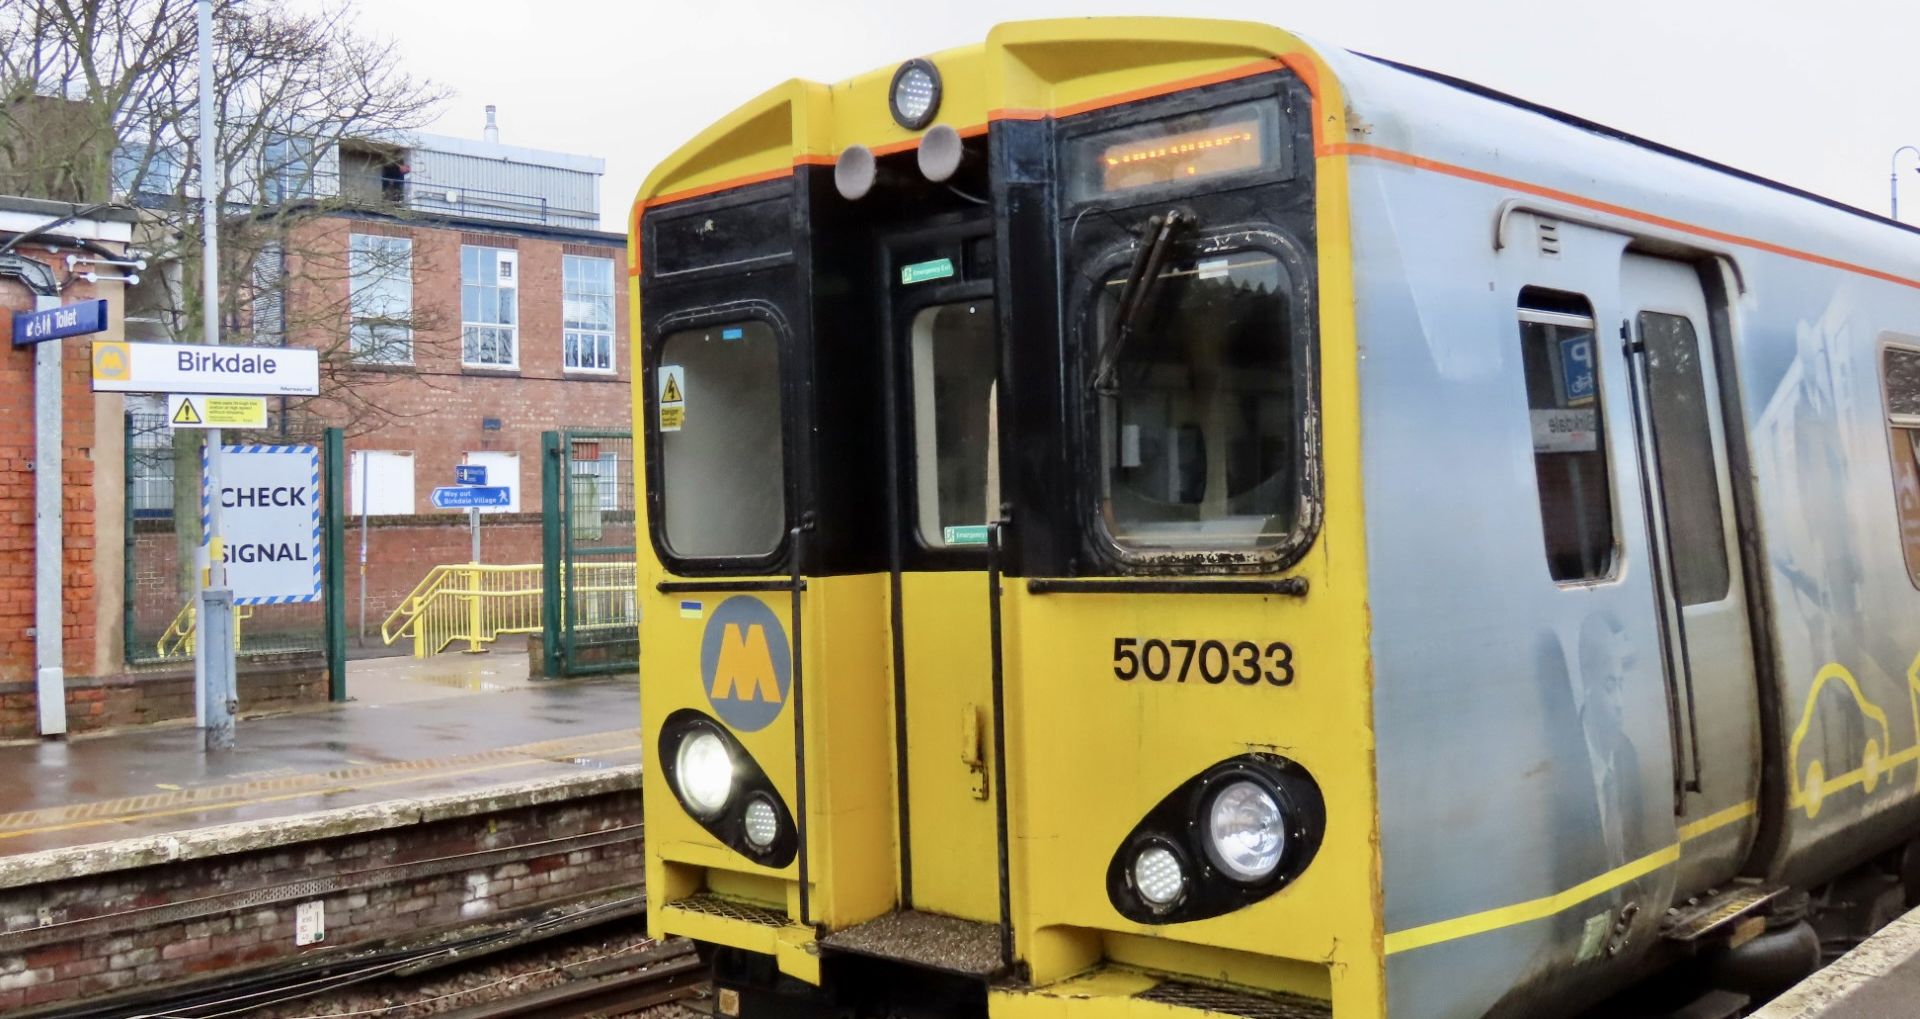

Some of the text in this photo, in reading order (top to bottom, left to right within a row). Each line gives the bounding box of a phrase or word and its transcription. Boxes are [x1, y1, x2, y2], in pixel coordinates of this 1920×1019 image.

[55, 307, 77, 329] Toilet
[178, 351, 277, 374] Birkdale
[221, 487, 306, 508] CHECK
[473, 497, 496, 505] Village
[711, 623, 782, 704] M
[1113, 637, 1295, 687] 507033
